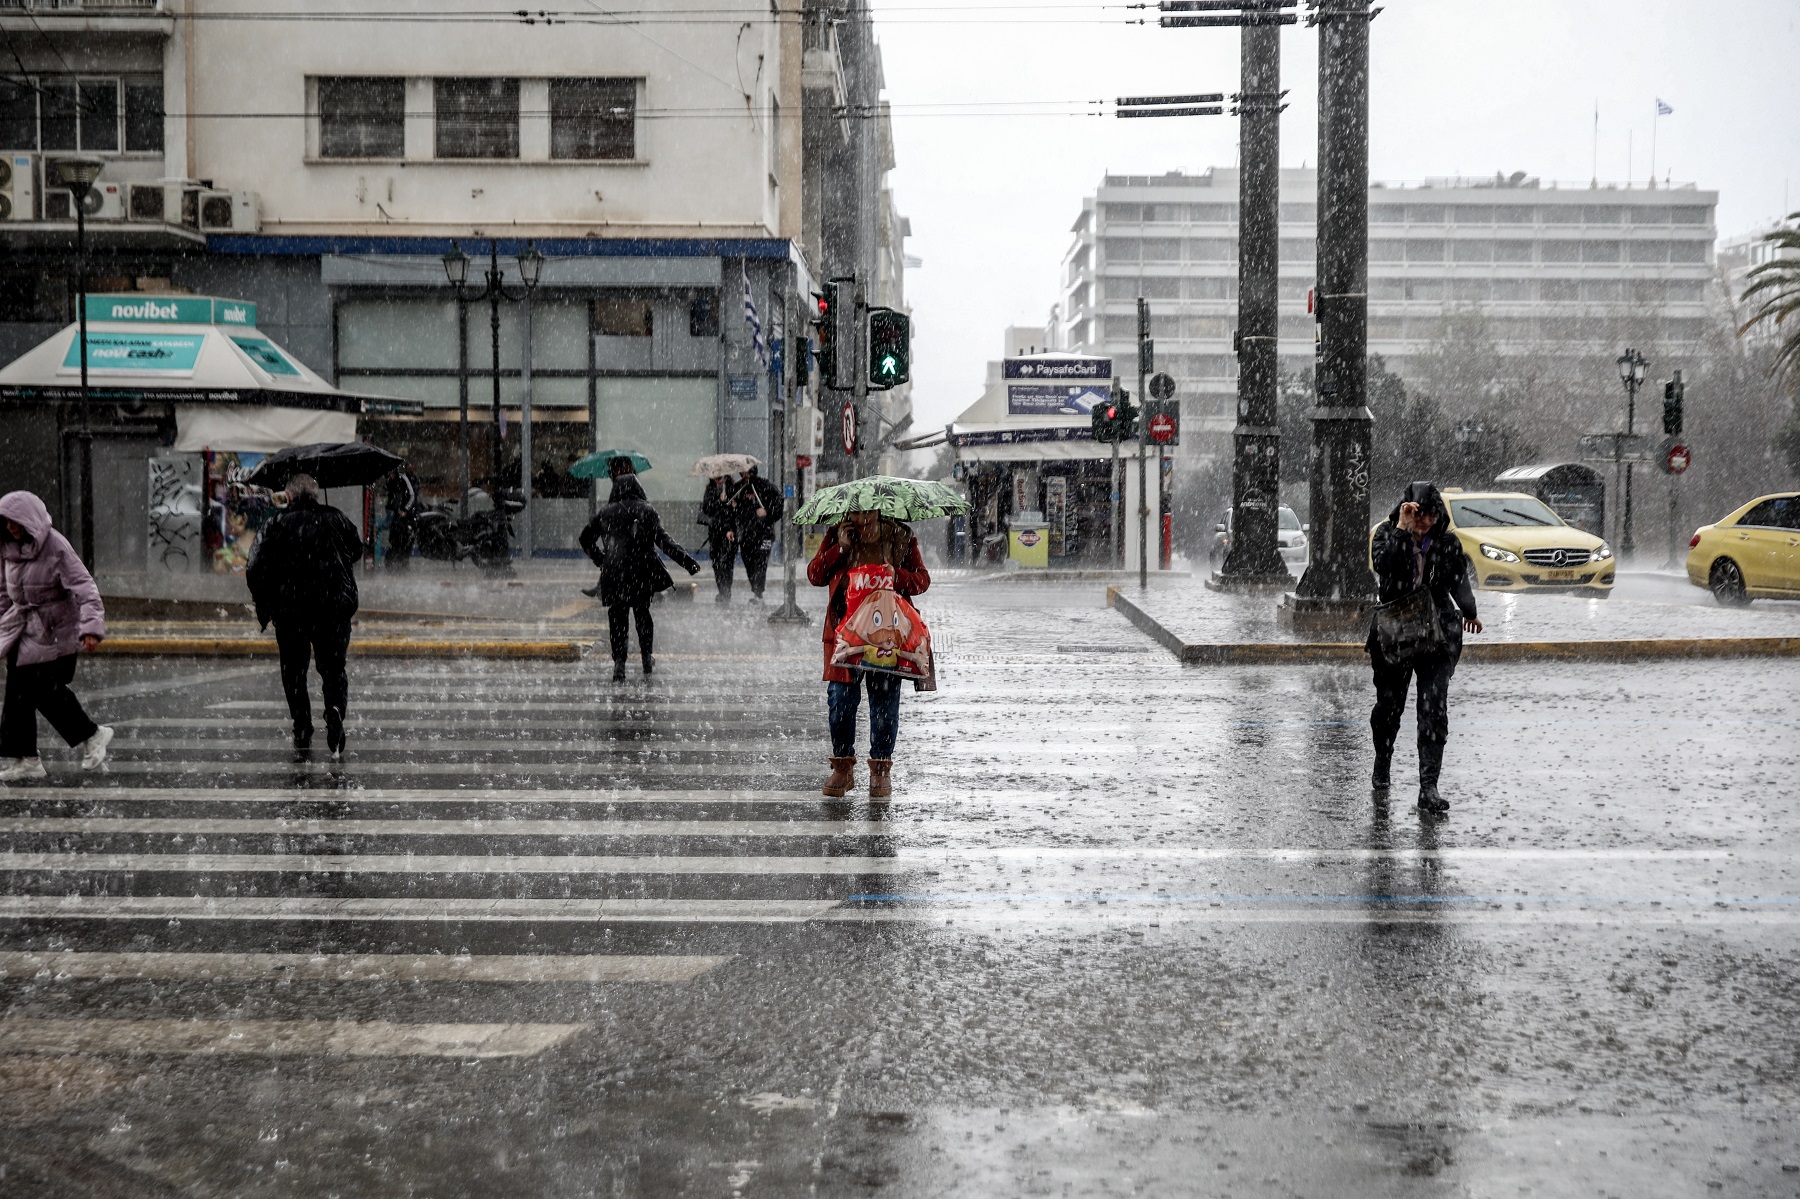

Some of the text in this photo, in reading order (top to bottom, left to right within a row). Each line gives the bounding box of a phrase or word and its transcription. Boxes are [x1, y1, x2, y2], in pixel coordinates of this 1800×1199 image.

[111, 301, 179, 320] novibet
[223, 305, 247, 323] novibet
[1036, 363, 1098, 376] PaysafeCard
[208, 391, 239, 401] novibet
